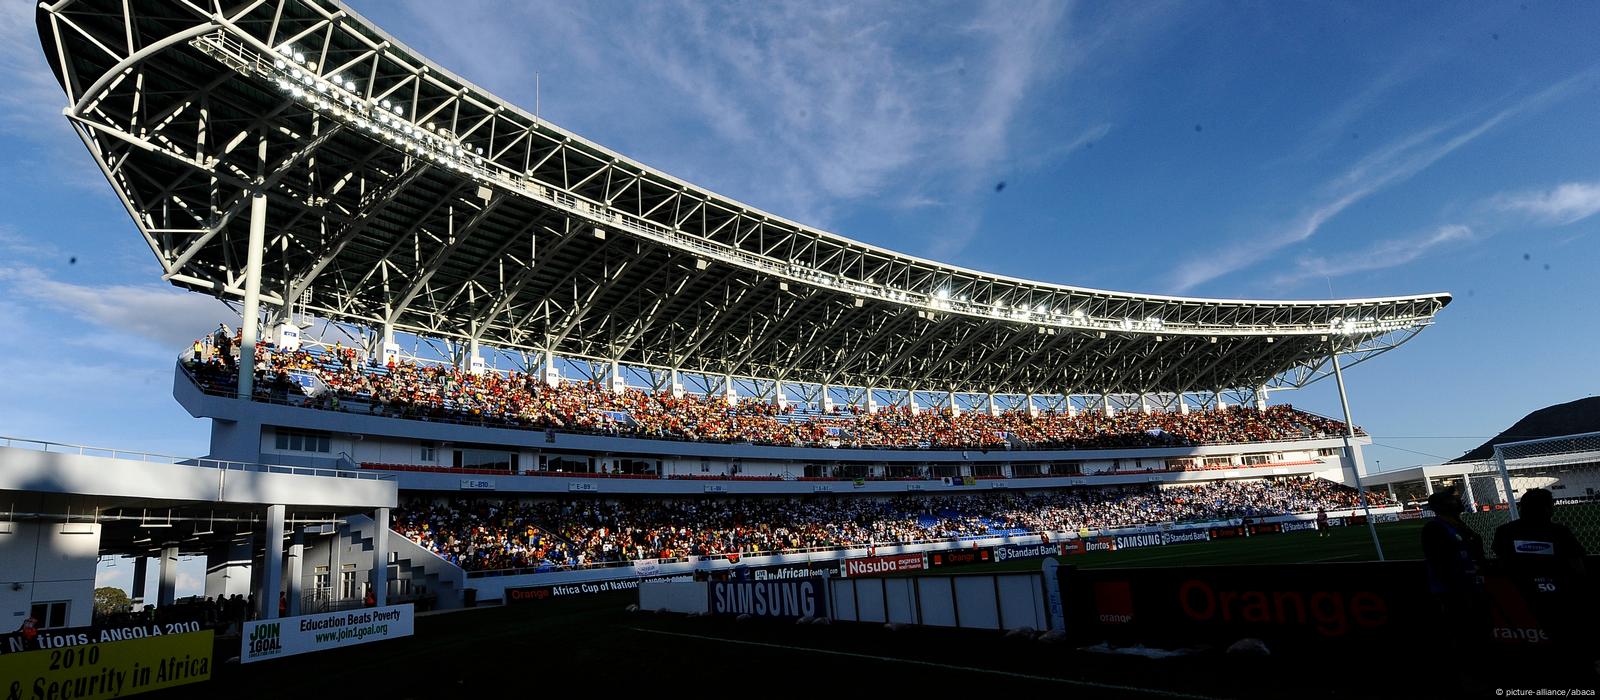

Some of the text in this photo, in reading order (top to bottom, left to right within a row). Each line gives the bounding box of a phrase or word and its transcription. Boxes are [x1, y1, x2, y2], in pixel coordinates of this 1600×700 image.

[1327, 518, 1341, 527] EPSI
[1117, 533, 1160, 549] SAMSUNG
[1170, 532, 1206, 543] Standard Bank
[1007, 545, 1057, 559] Standard Bank
[1086, 541, 1110, 552] Doritos
[849, 558, 897, 575] Nàsuba
[512, 588, 549, 600] Orange
[553, 585, 580, 596] Africa
[581, 583, 599, 595] Cup
[600, 582, 609, 591] of
[1538, 582, 1556, 592] 50
[715, 581, 815, 618] SAMSUNG
[1176, 577, 1390, 638] Orange
[300, 609, 401, 632] Education Beats Poverty
[1099, 614, 1133, 624] orange
[100, 623, 162, 643] ANGOLA
[166, 621, 200, 635] 2010
[250, 622, 280, 640] JOIN
[315, 623, 388, 644] www.join1goal.org
[1493, 627, 1550, 643] range
[249, 637, 282, 654] 1GOAL
[49, 645, 100, 671] 2010
[6, 654, 209, 700] & Security in Africa
